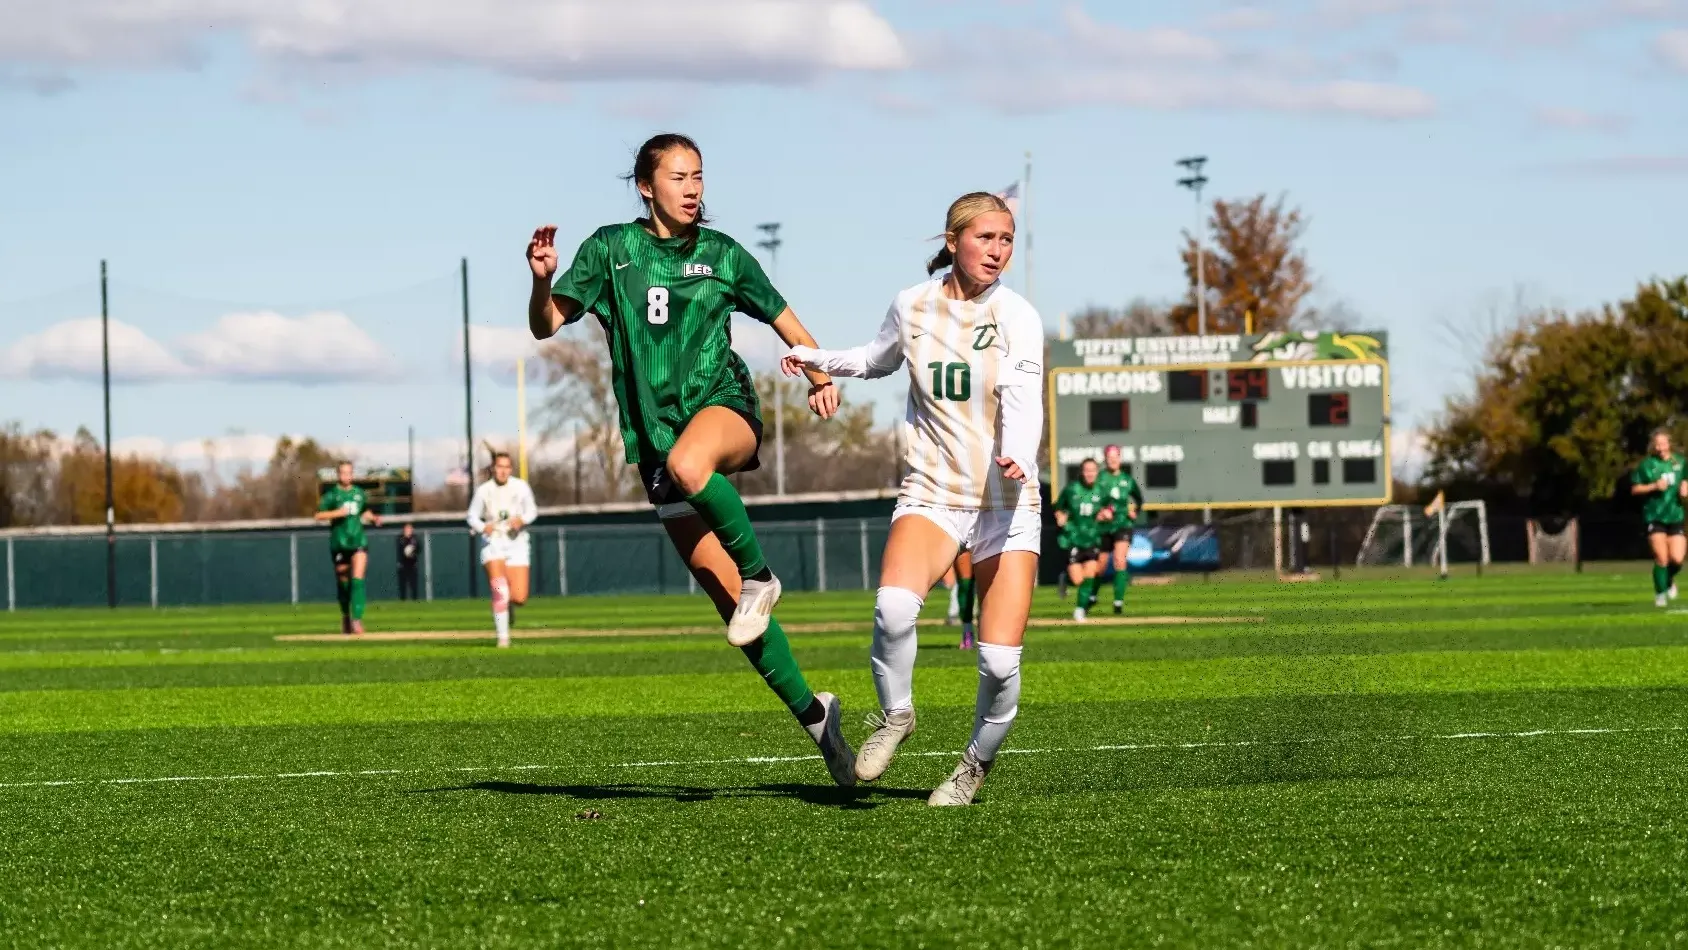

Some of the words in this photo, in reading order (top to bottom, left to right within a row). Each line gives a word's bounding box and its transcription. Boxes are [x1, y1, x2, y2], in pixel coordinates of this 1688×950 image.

[647, 286, 669, 325] 8
[1134, 334, 1241, 354] UNIVERSITY
[927, 361, 971, 402] 10
[1056, 371, 1162, 395] DRAGONS
[1280, 364, 1382, 388] VISITOR
[1329, 393, 1350, 426] 2
